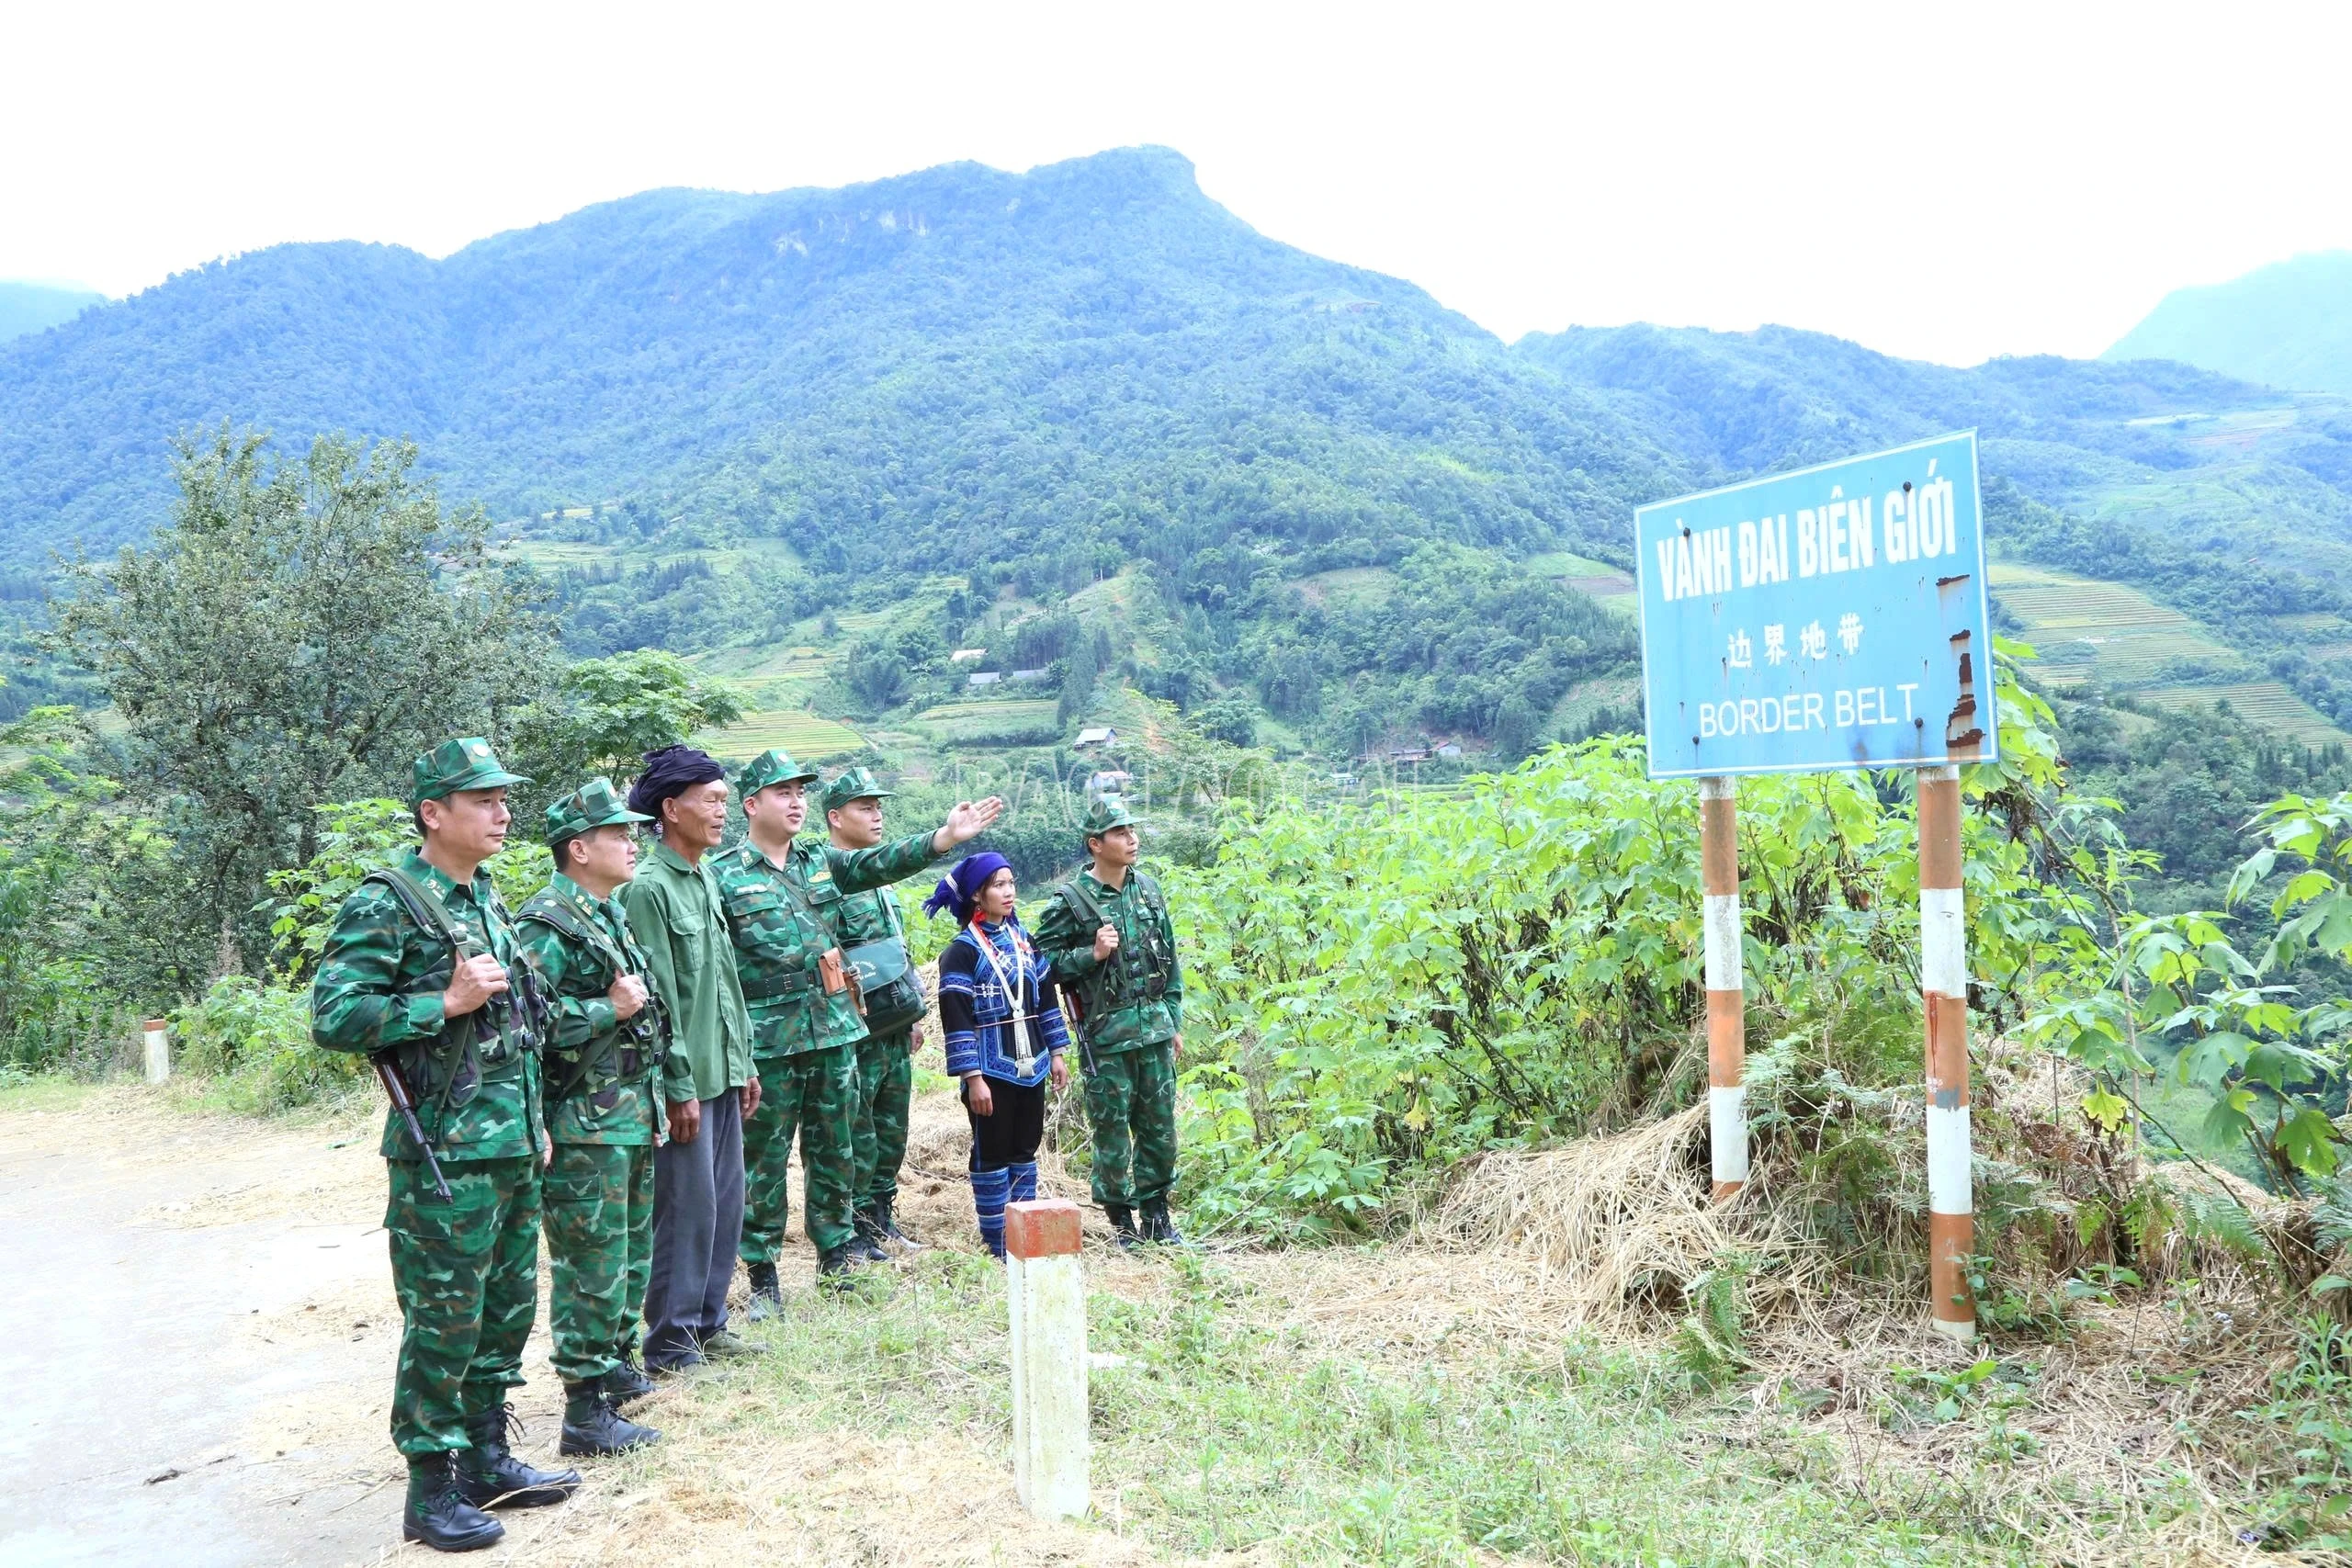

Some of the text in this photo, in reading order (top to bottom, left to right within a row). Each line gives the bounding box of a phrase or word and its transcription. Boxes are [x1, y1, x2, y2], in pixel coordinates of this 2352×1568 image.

[1657, 458, 1956, 602] VÀNH ĐAI BIÊN GIỚI
[1727, 612, 1864, 669] 边界地带
[1699, 683, 1919, 739] BORDER BELT
